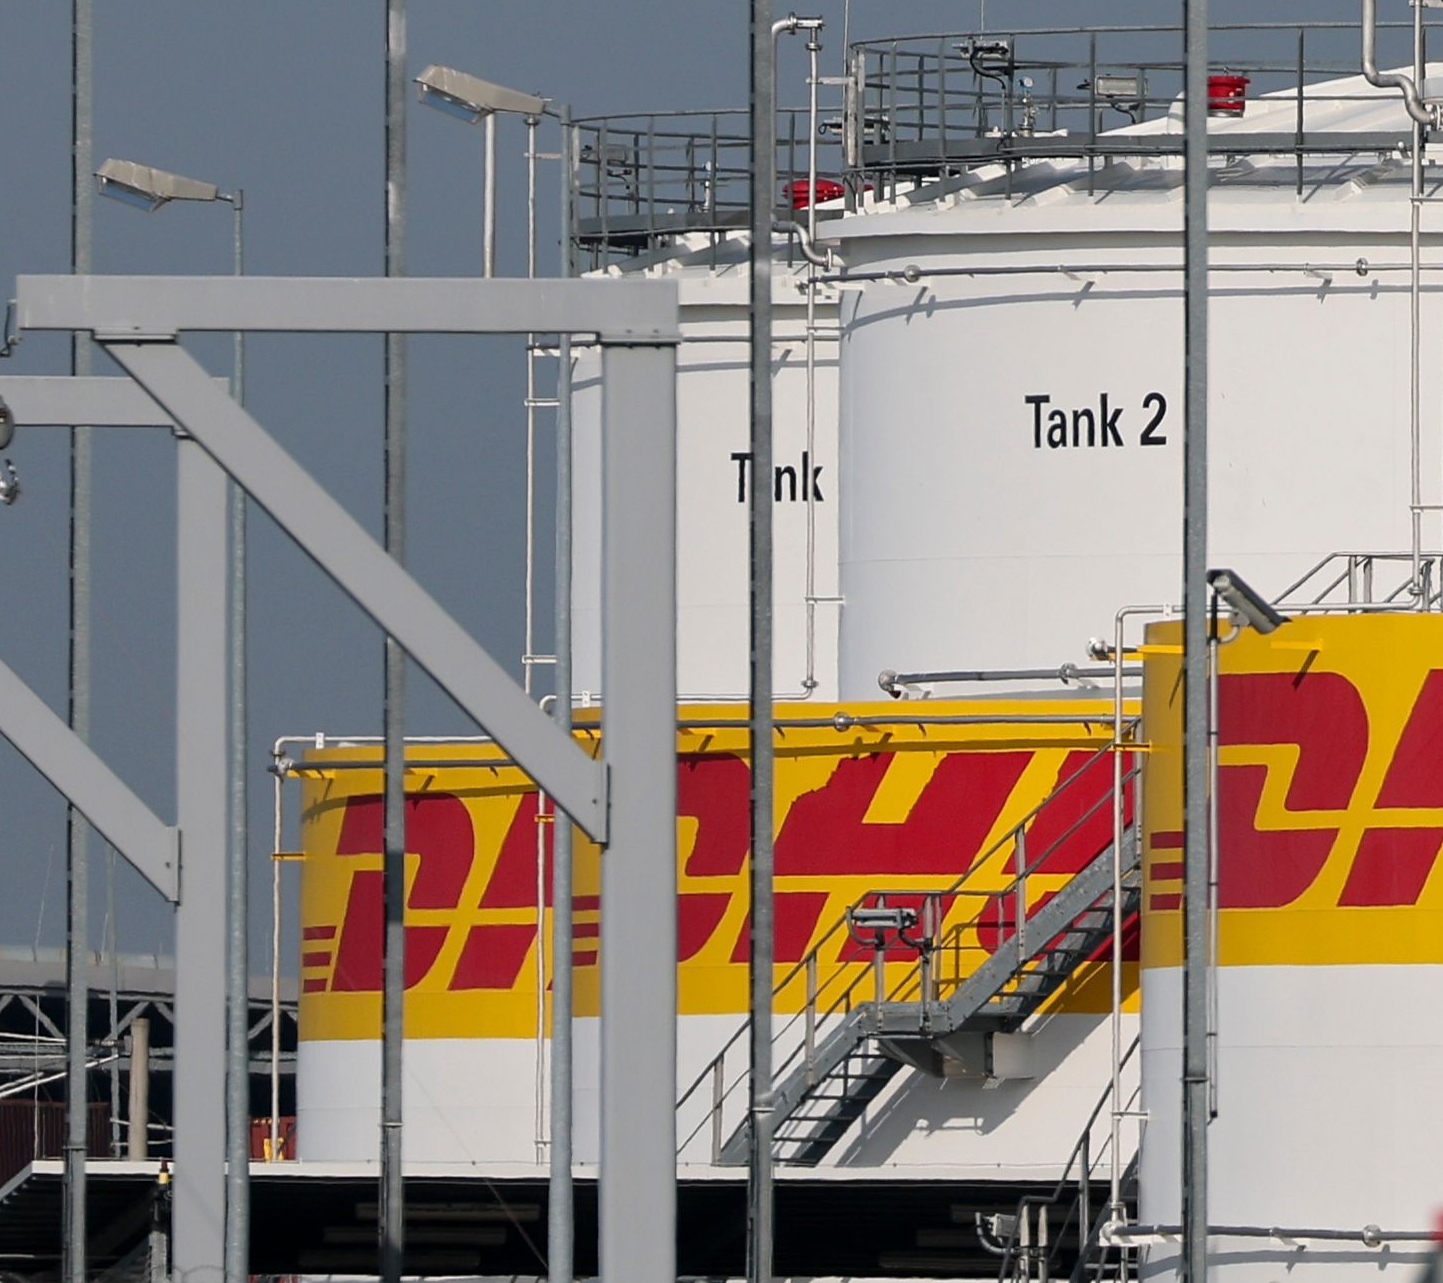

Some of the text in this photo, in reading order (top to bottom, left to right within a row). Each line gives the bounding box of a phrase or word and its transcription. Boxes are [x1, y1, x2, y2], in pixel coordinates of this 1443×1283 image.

[1025, 392, 1167, 448] Tank 2
[731, 451, 824, 502] Tnk
